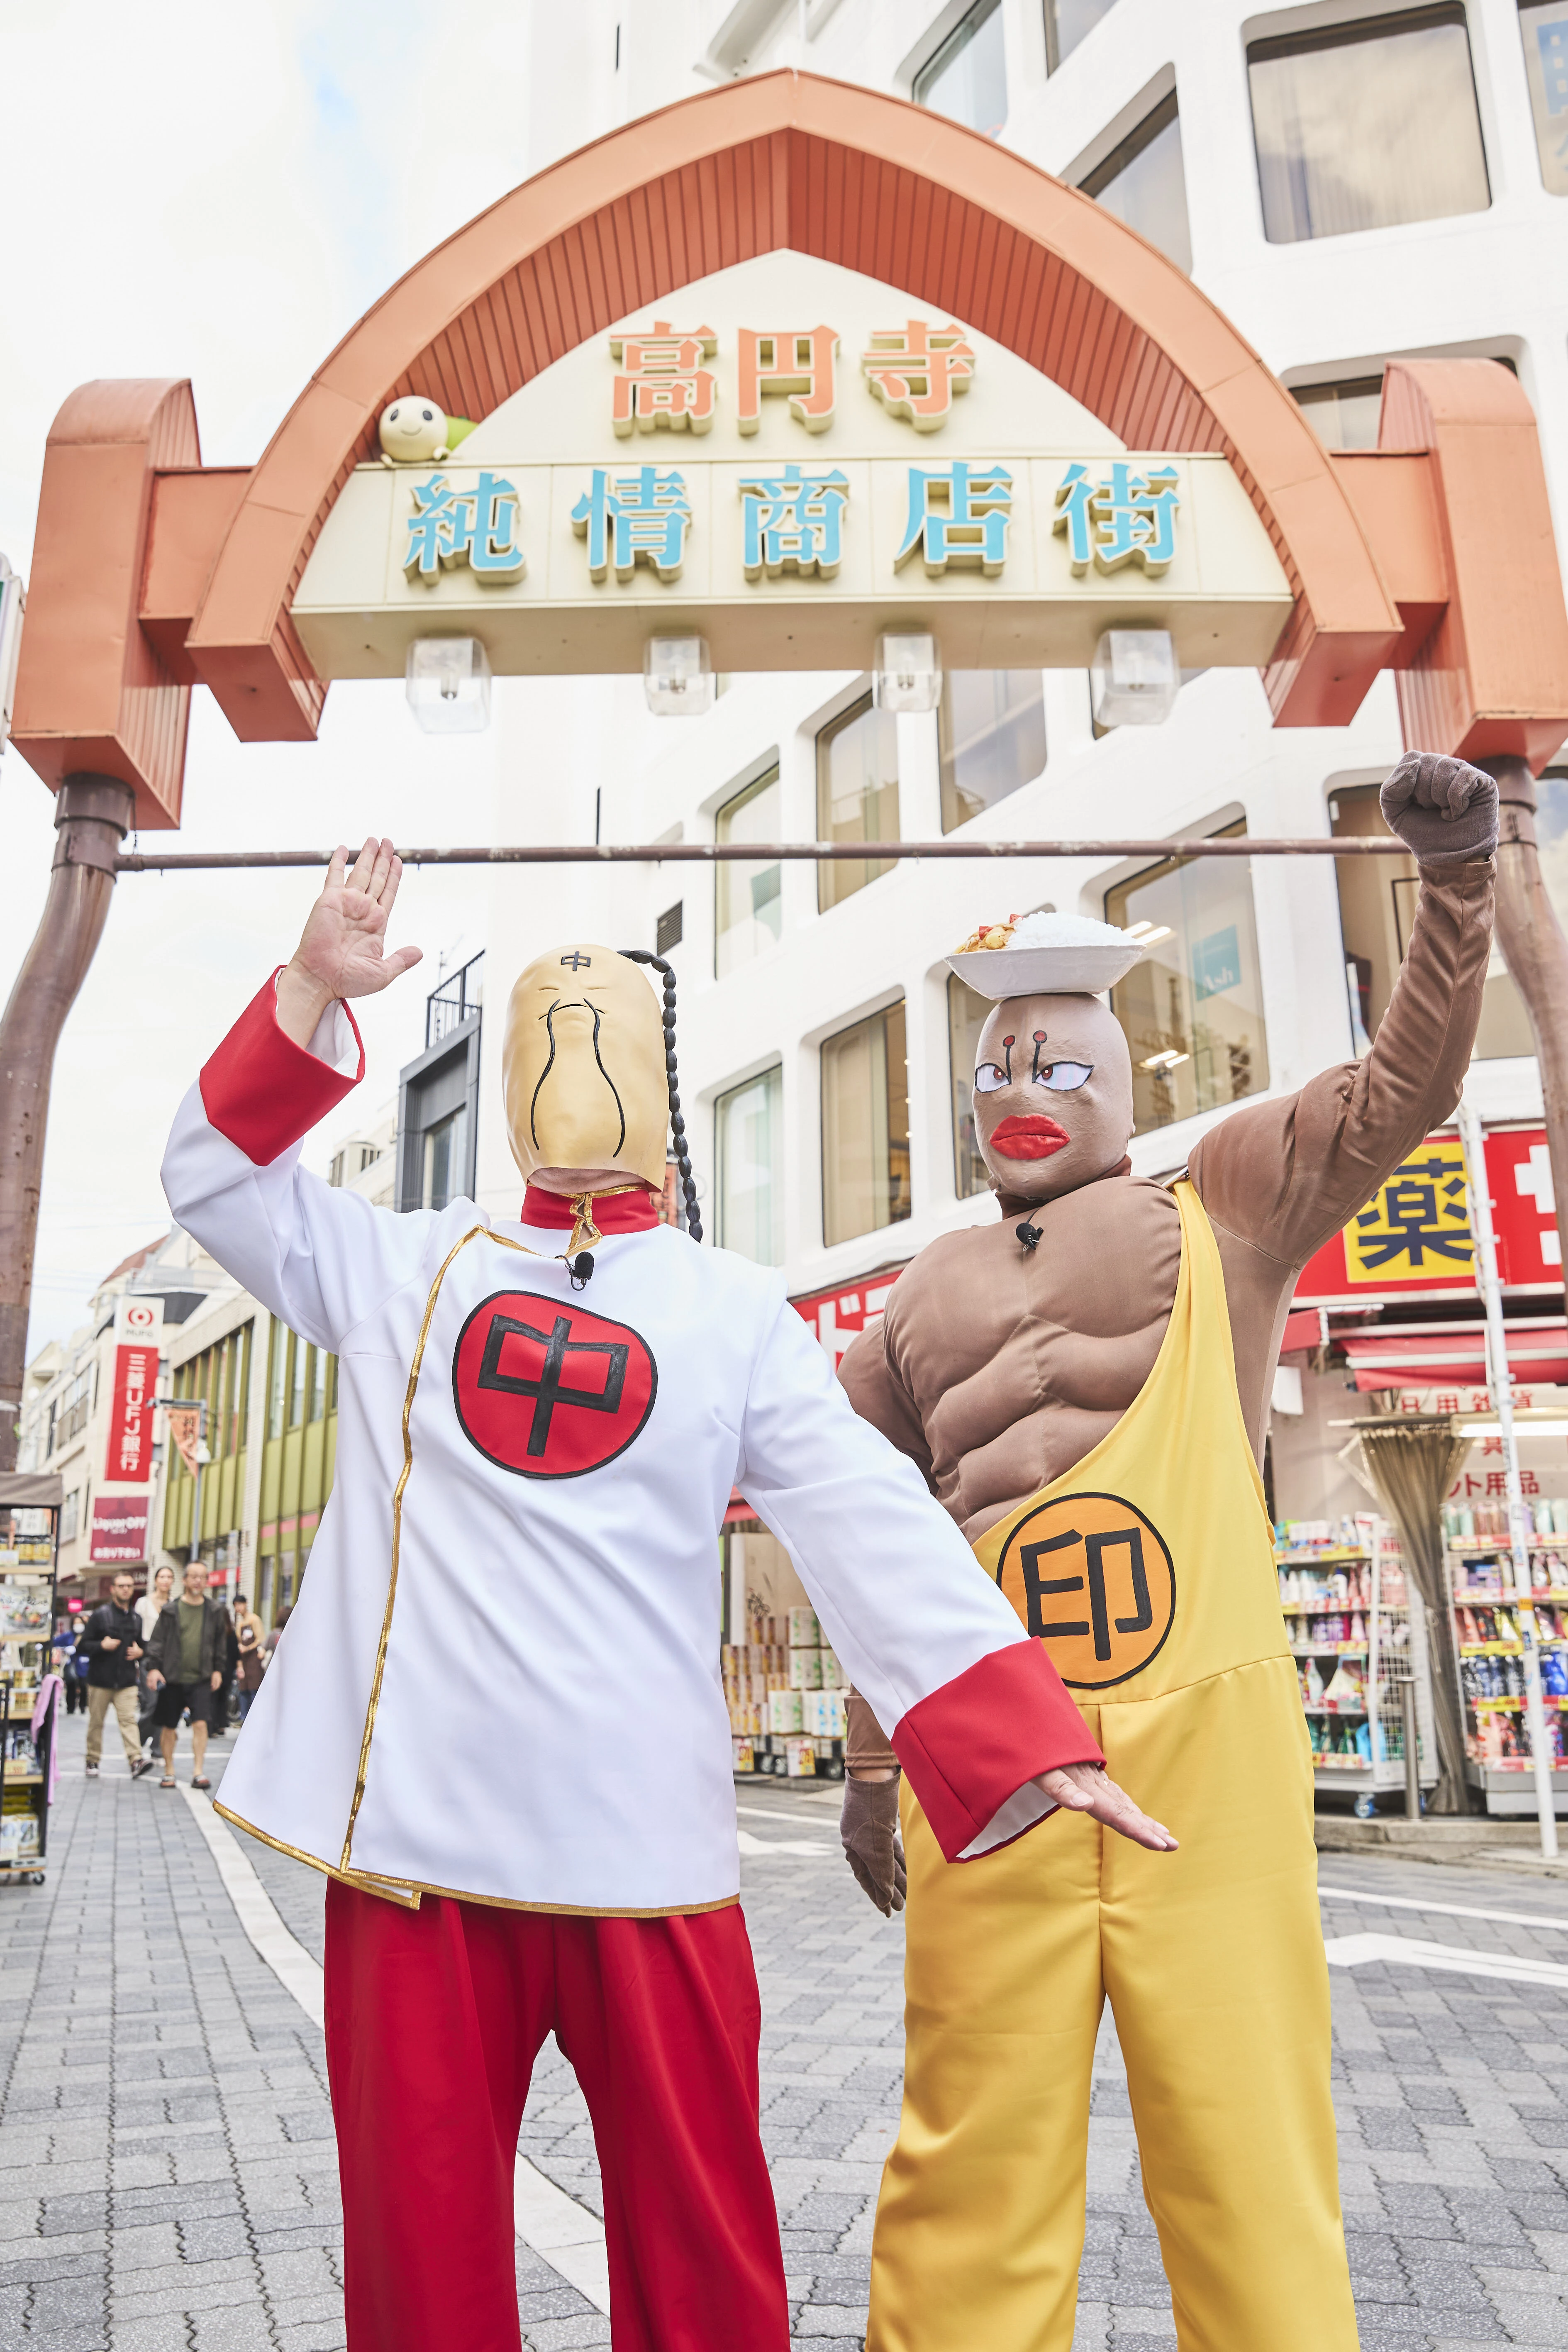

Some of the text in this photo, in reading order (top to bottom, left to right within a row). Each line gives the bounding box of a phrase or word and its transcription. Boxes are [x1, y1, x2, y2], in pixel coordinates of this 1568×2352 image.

[608, 319, 977, 425] 高円寺
[403, 461, 1182, 572] 純情商店街
[561, 951, 591, 971] 中
[1355, 1158, 1474, 1270] 薬
[120, 1353, 146, 1471] 三菱UFJ銀行
[477, 1314, 629, 1458] 中
[1020, 1527, 1153, 1662] 印
